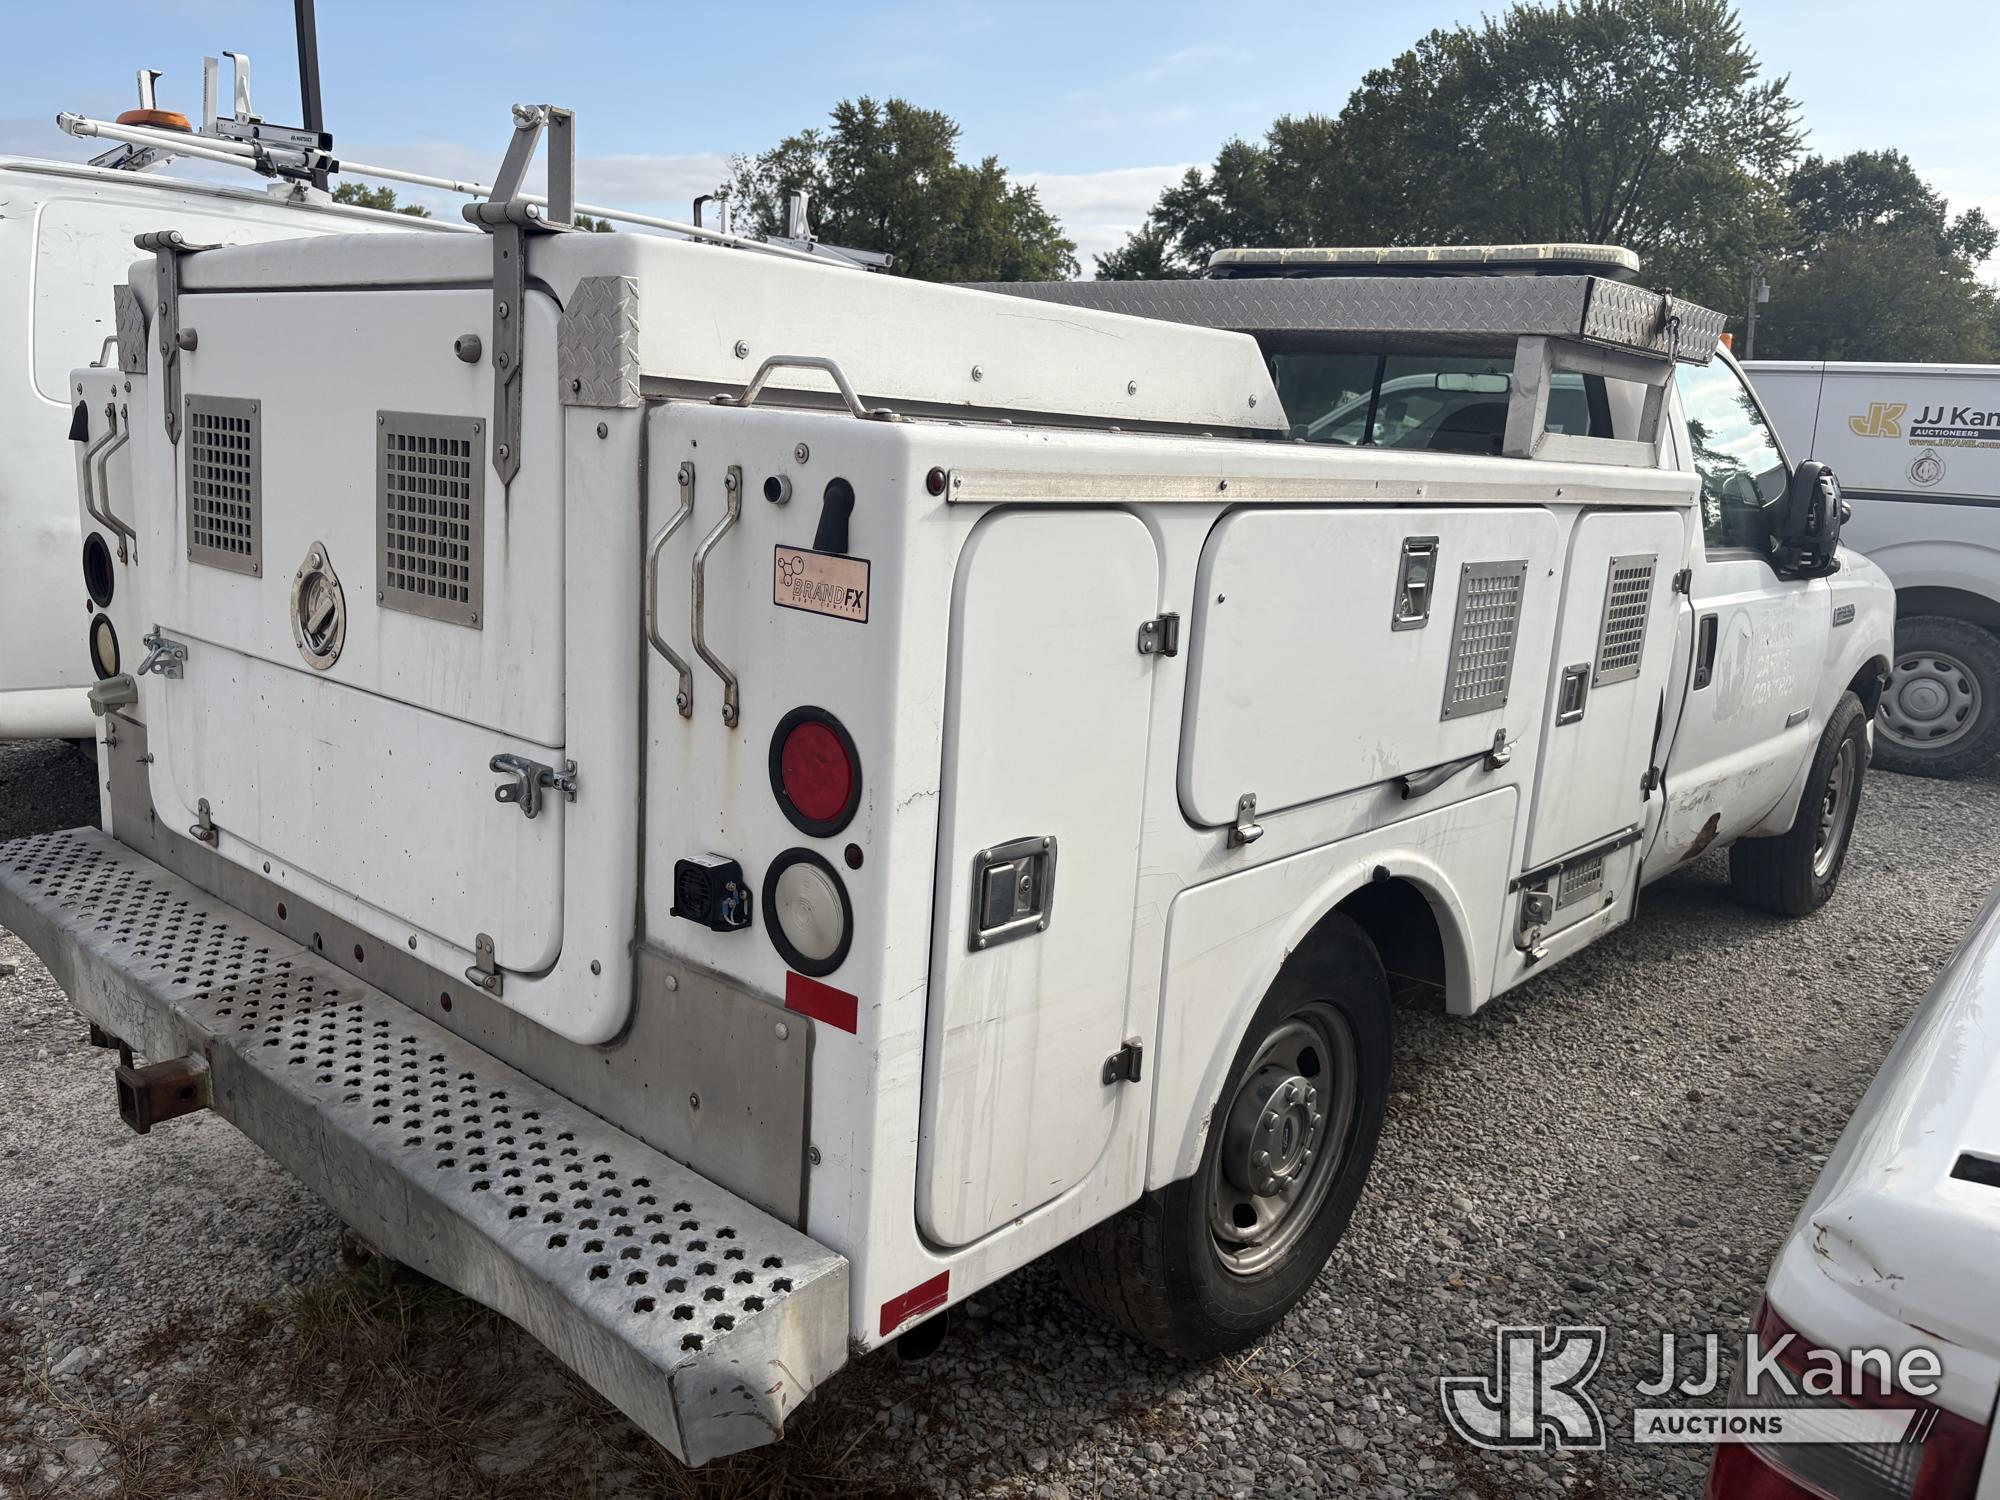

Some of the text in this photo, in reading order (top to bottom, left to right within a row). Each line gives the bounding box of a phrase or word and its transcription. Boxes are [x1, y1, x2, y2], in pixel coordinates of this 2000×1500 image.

[1913, 406, 1944, 425] JJ
[1950, 406, 2000, 427] Kan
[1915, 428, 1979, 437] AUCTIONEERS
[793, 578, 864, 608] BRANDFX
